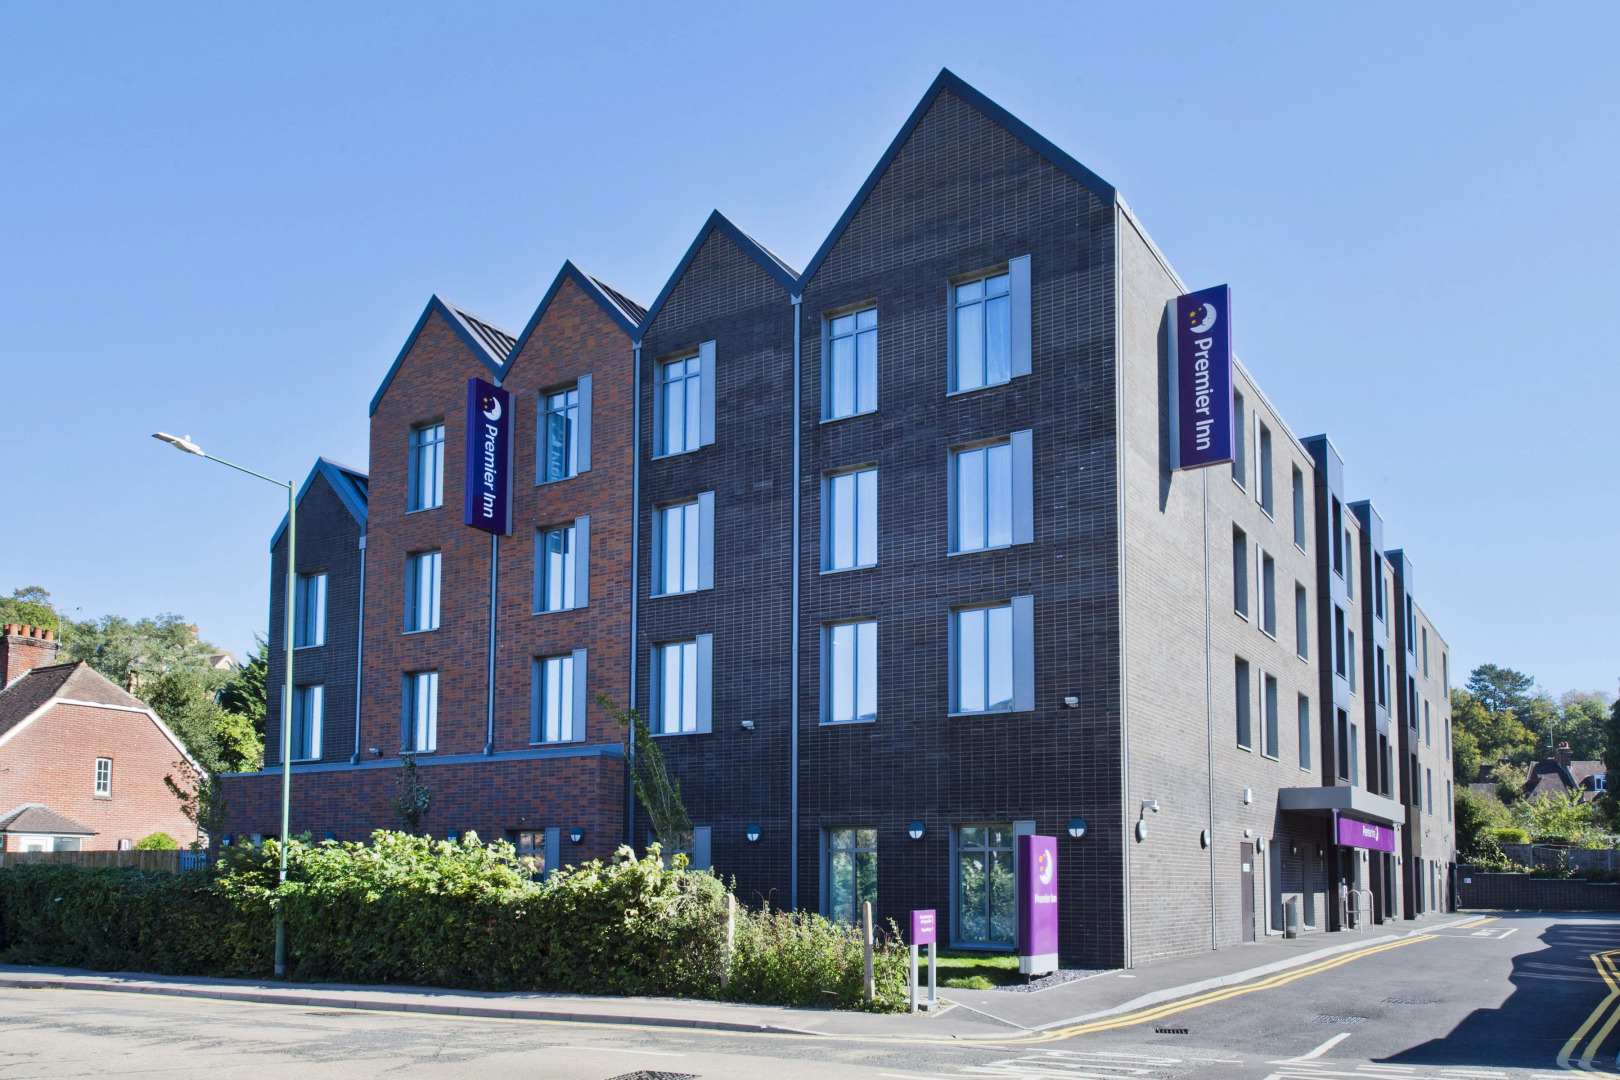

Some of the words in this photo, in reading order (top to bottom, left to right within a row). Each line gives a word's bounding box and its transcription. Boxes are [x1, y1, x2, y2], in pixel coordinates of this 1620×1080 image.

[1194, 337, 1214, 416] Premier
[484, 423, 498, 491] Premier
[1195, 418, 1214, 451] Inn
[483, 492, 497, 518] Inn
